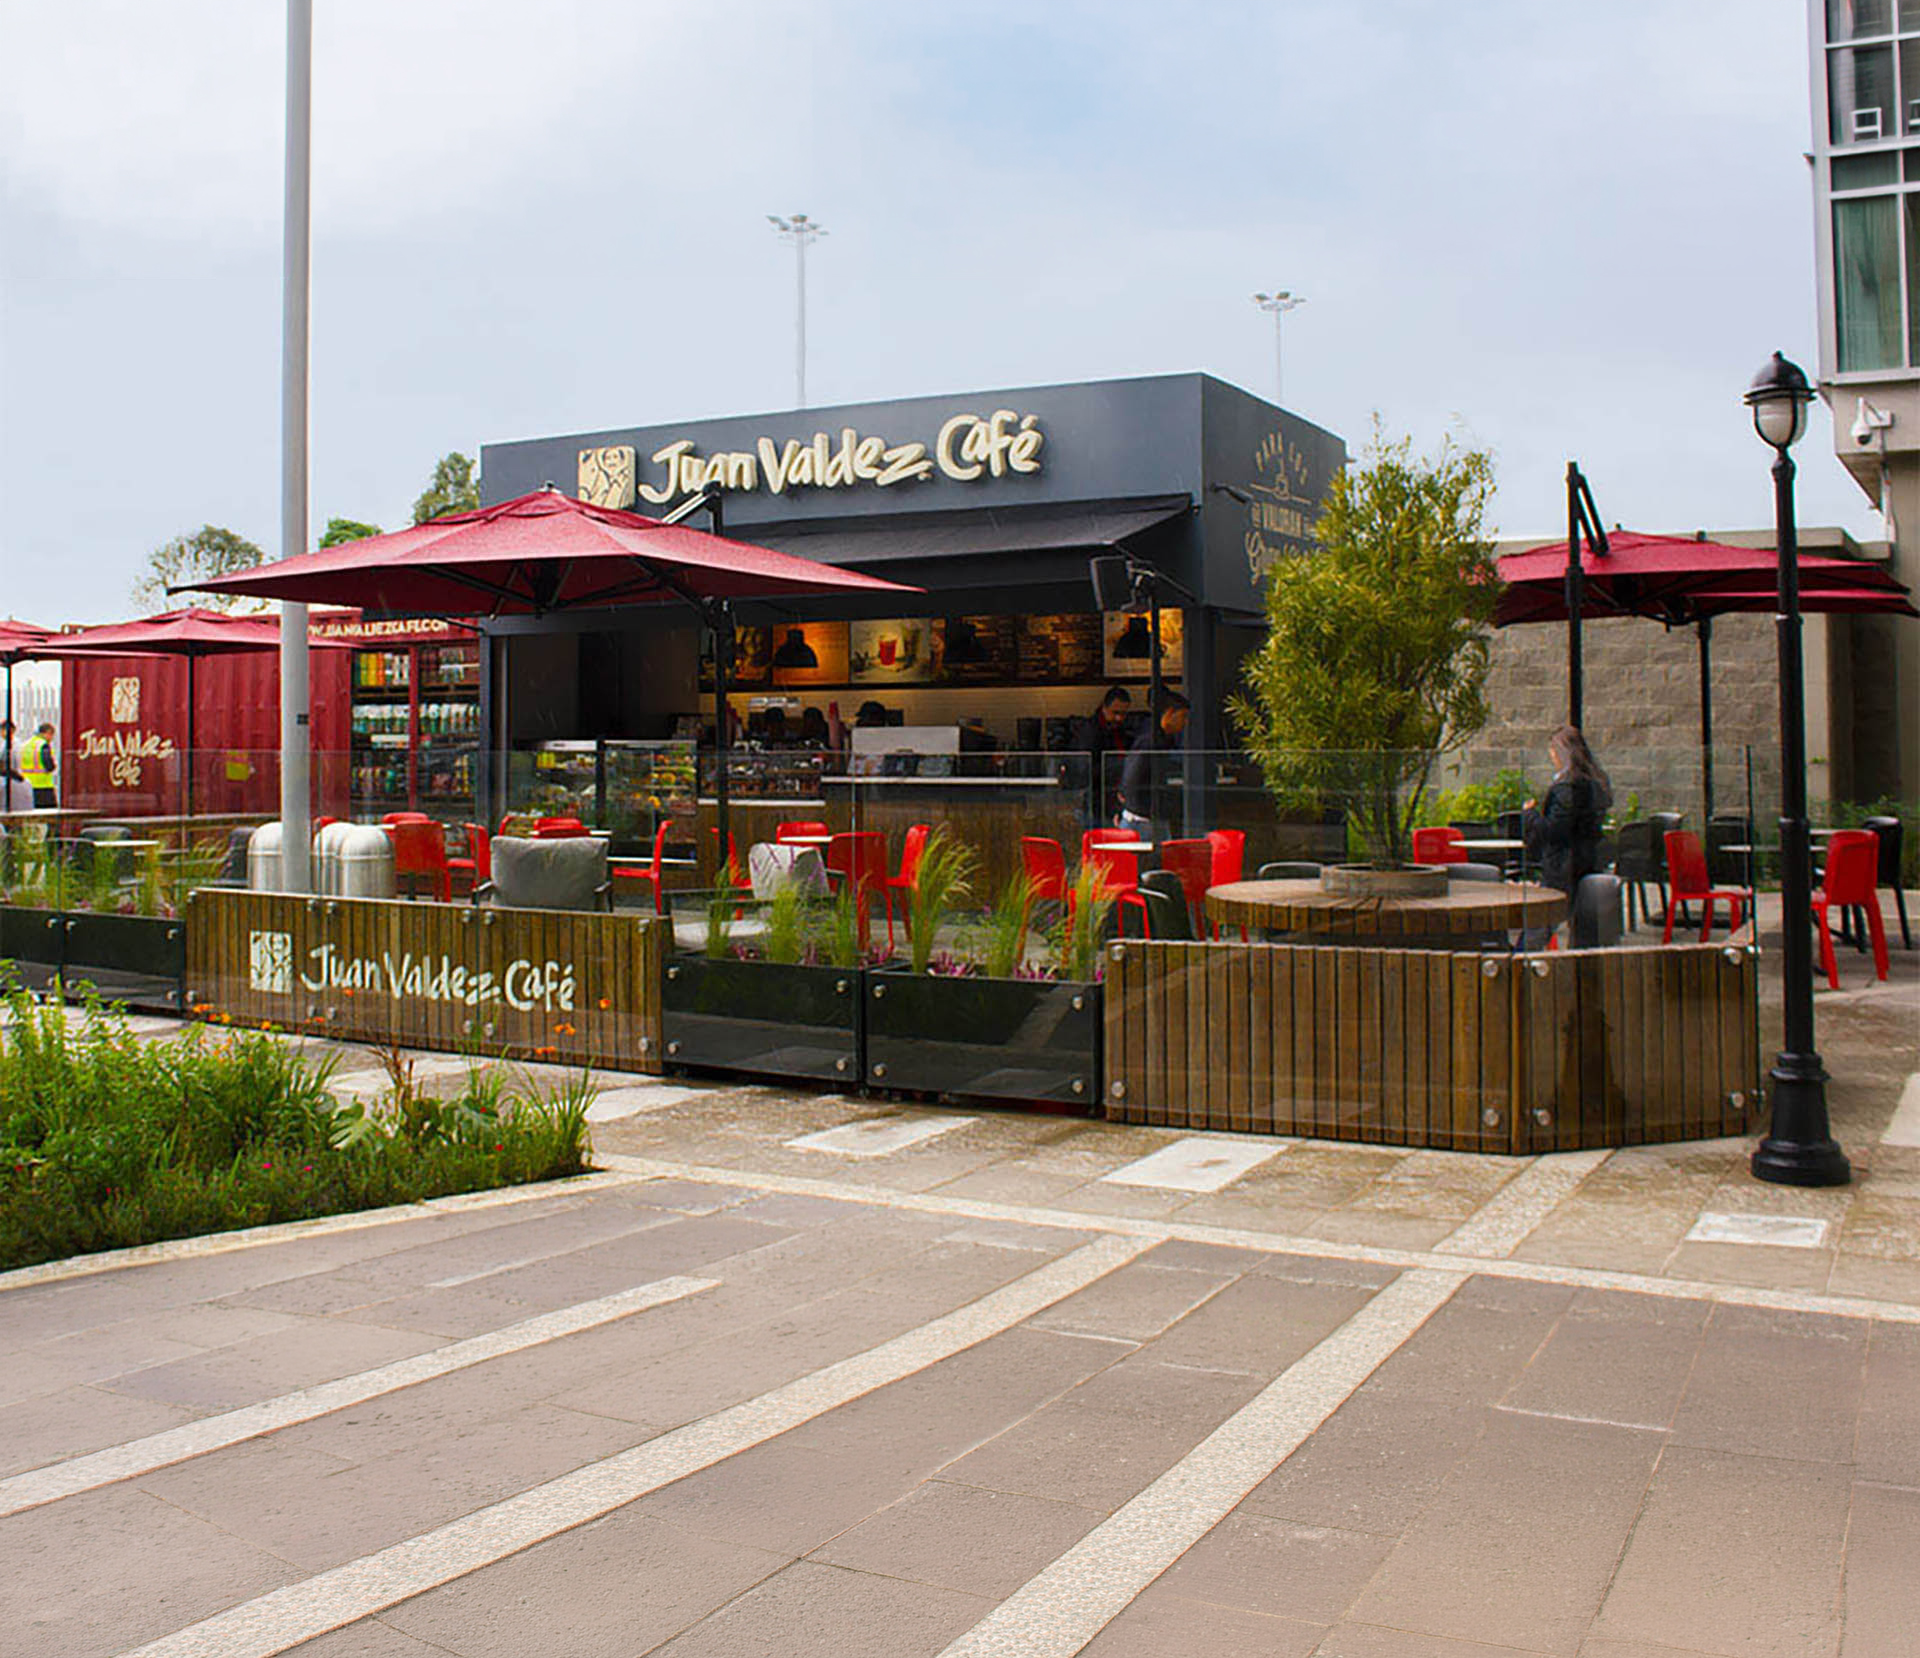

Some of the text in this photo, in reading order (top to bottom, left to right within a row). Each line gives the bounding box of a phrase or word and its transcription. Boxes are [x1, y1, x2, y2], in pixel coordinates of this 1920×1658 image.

[638, 440, 758, 504] Juan
[936, 409, 1043, 482] Café
[300, 943, 383, 992] Juan
[503, 959, 576, 1013] Café
